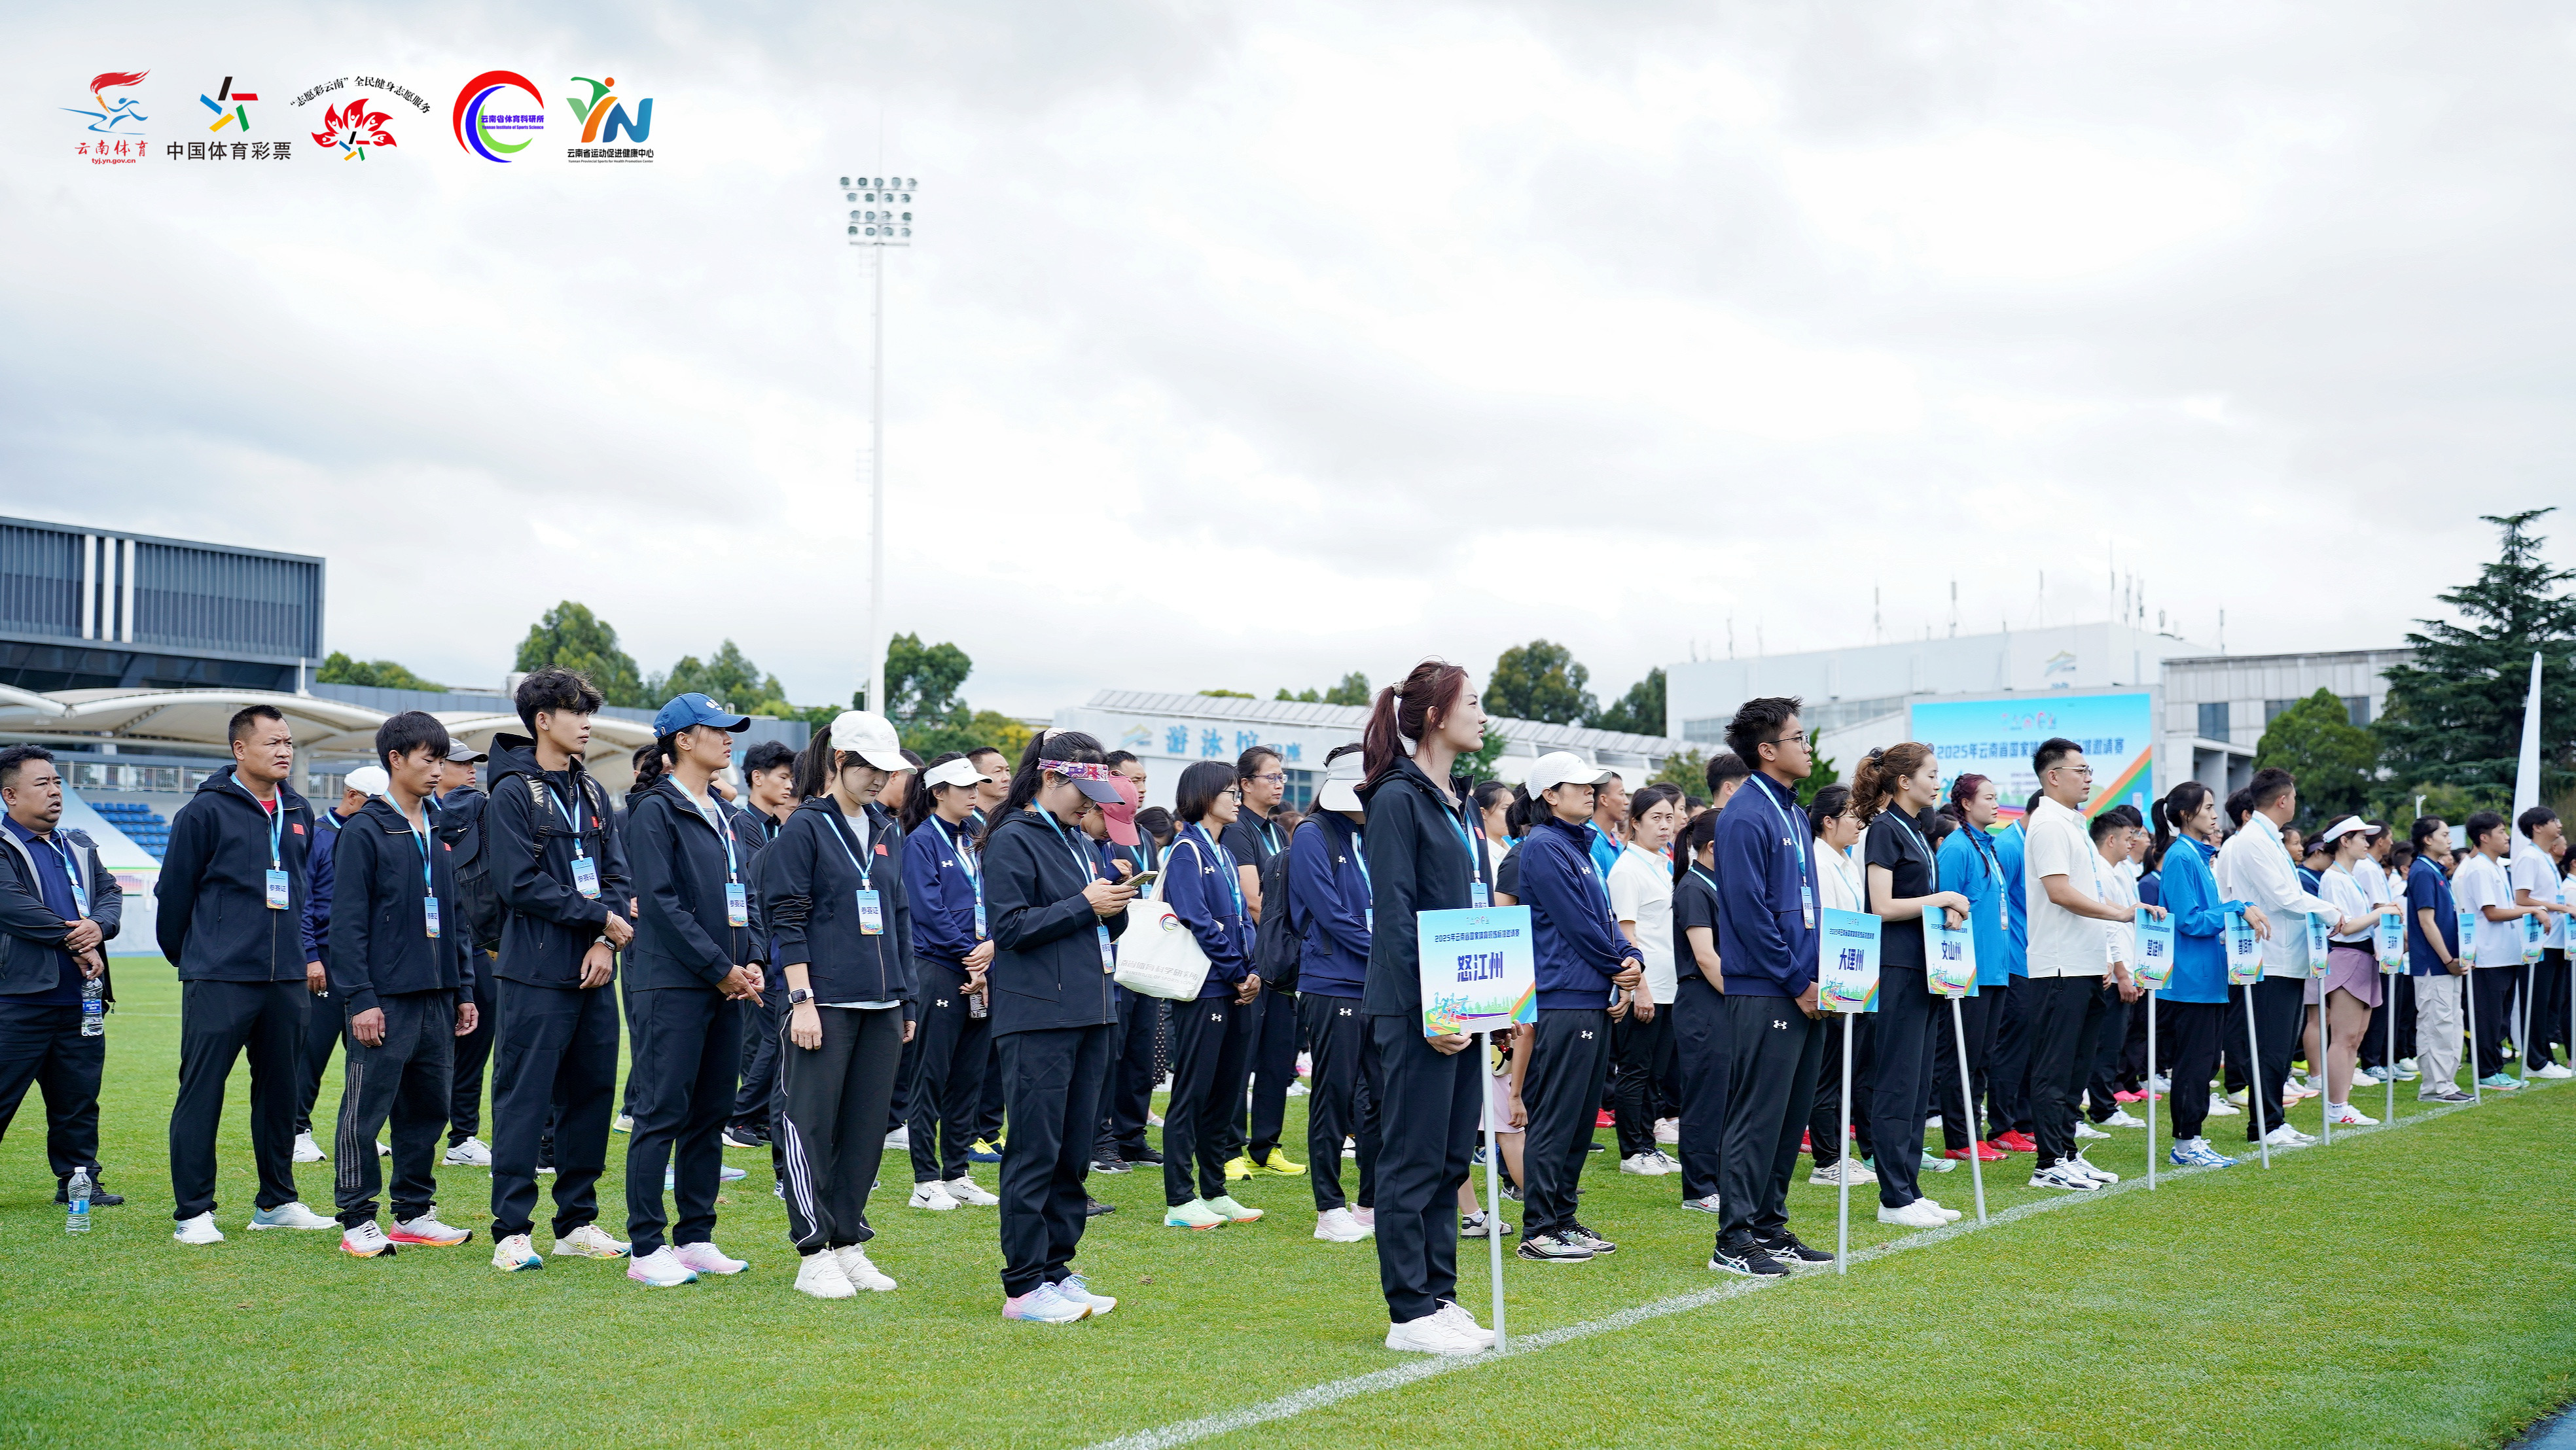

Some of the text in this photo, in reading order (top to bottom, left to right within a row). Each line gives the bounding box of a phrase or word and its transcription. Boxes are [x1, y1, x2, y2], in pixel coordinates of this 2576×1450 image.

[1839, 948, 1864, 971] 大理州
[1941, 940, 1961, 961] 文山州
[1457, 951, 1503, 981] 怒江州
